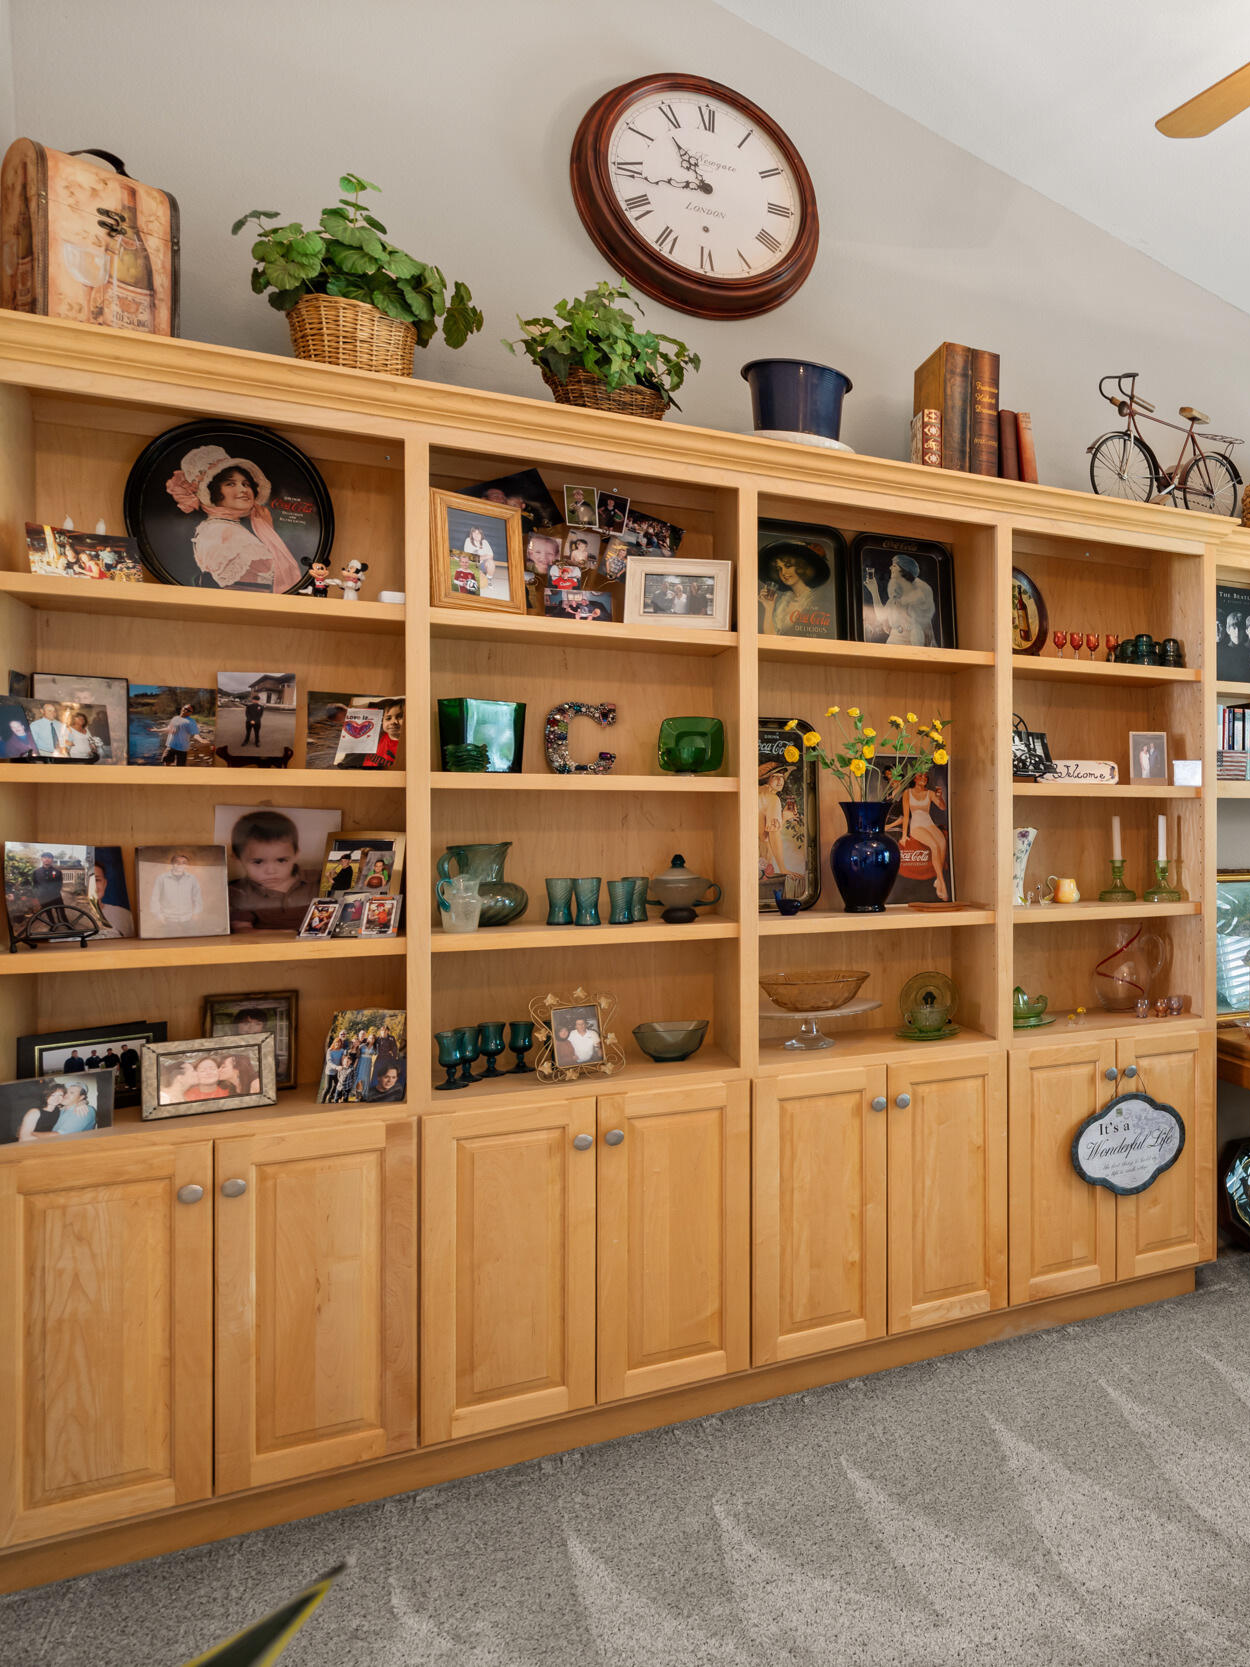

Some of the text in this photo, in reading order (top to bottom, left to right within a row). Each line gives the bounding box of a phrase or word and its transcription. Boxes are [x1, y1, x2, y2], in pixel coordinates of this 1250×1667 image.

[685, 202, 727, 219] LONDON
[544, 702, 616, 774] C
[1052, 763, 1106, 779] Welcome
[1099, 1122, 1131, 1136] It's a
[1086, 1126, 1175, 1161] Wonderful Life
